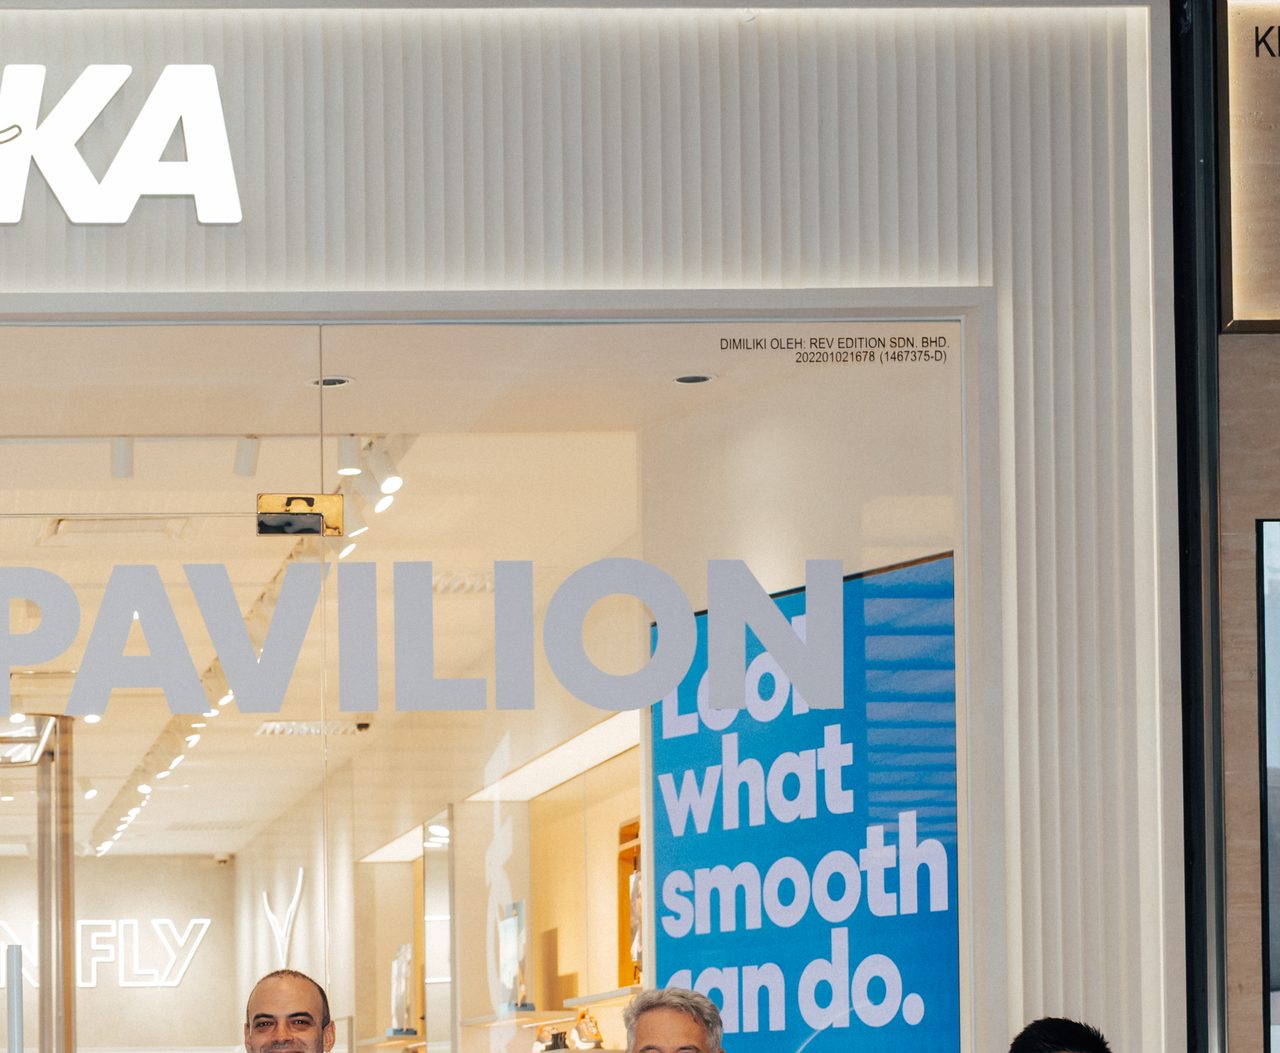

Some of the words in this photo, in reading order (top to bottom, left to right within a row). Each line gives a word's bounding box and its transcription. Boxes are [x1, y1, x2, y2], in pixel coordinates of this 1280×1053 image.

[720, 338, 767, 350] DIMILIKI
[770, 338, 806, 350] OLEH:
[810, 338, 834, 349] REV
[838, 337, 886, 349] EDITION
[889, 337, 918, 348] SDN.
[921, 336, 950, 348] BHD.
[795, 351, 875, 363] 202201021678
[880, 350, 947, 364] (1467375-D)
[658, 723, 854, 838] what
[661, 810, 949, 939] smooth
[75, 918, 212, 988] FLY
[797, 926, 925, 1029] do.
